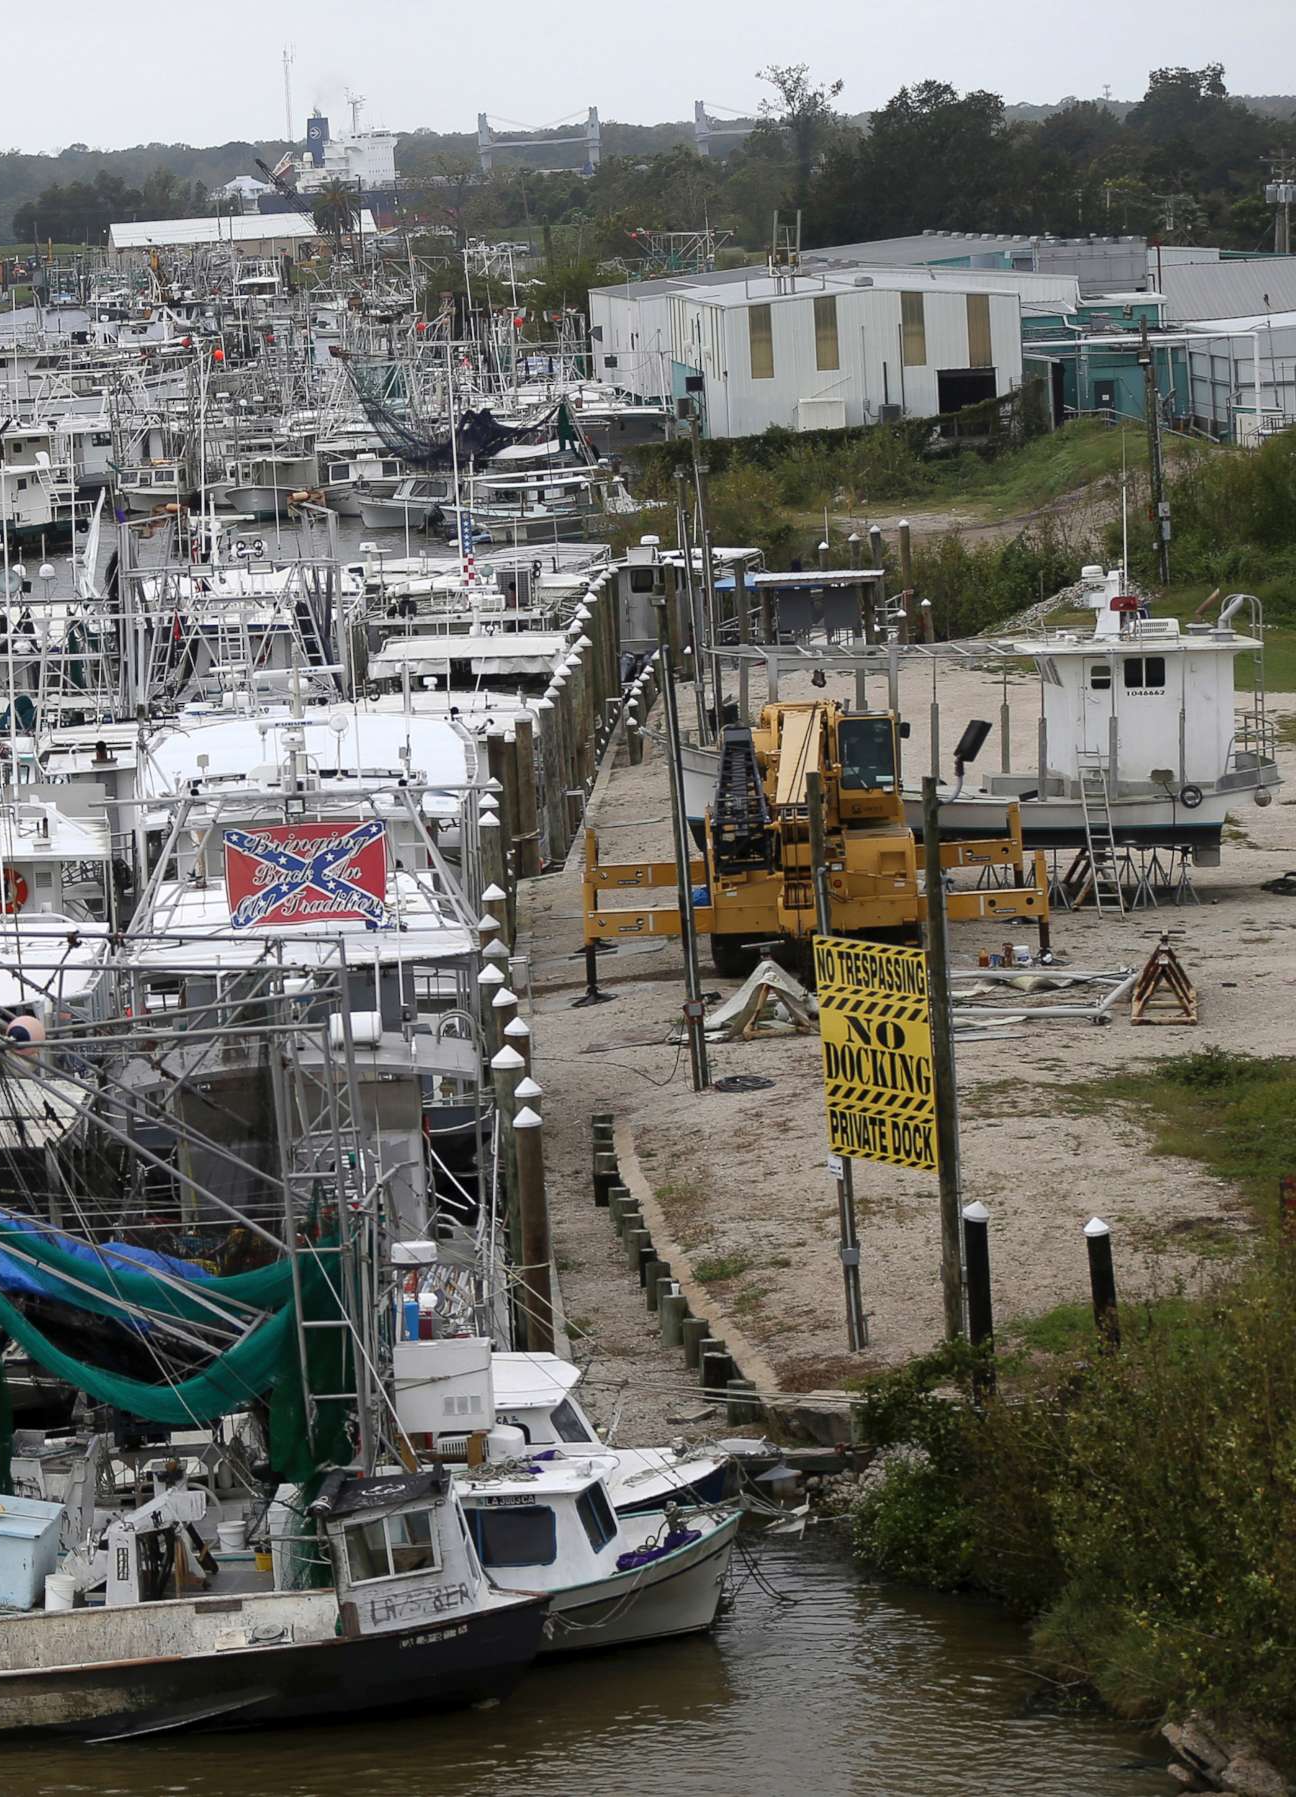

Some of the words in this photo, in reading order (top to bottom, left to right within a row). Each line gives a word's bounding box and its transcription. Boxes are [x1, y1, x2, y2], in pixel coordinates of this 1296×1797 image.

[243, 831, 369, 860] Bringing
[253, 860, 314, 886] Back
[321, 858, 362, 881] An
[236, 893, 272, 918] Old
[282, 890, 383, 917] Tradition
[816, 947, 835, 983] NO
[837, 950, 926, 996] TRESPASSING
[844, 1015, 906, 1050] NO
[824, 1041, 931, 1096] DOCKING
[830, 1108, 888, 1154] PRIVATE
[891, 1119, 934, 1163] DOCK
